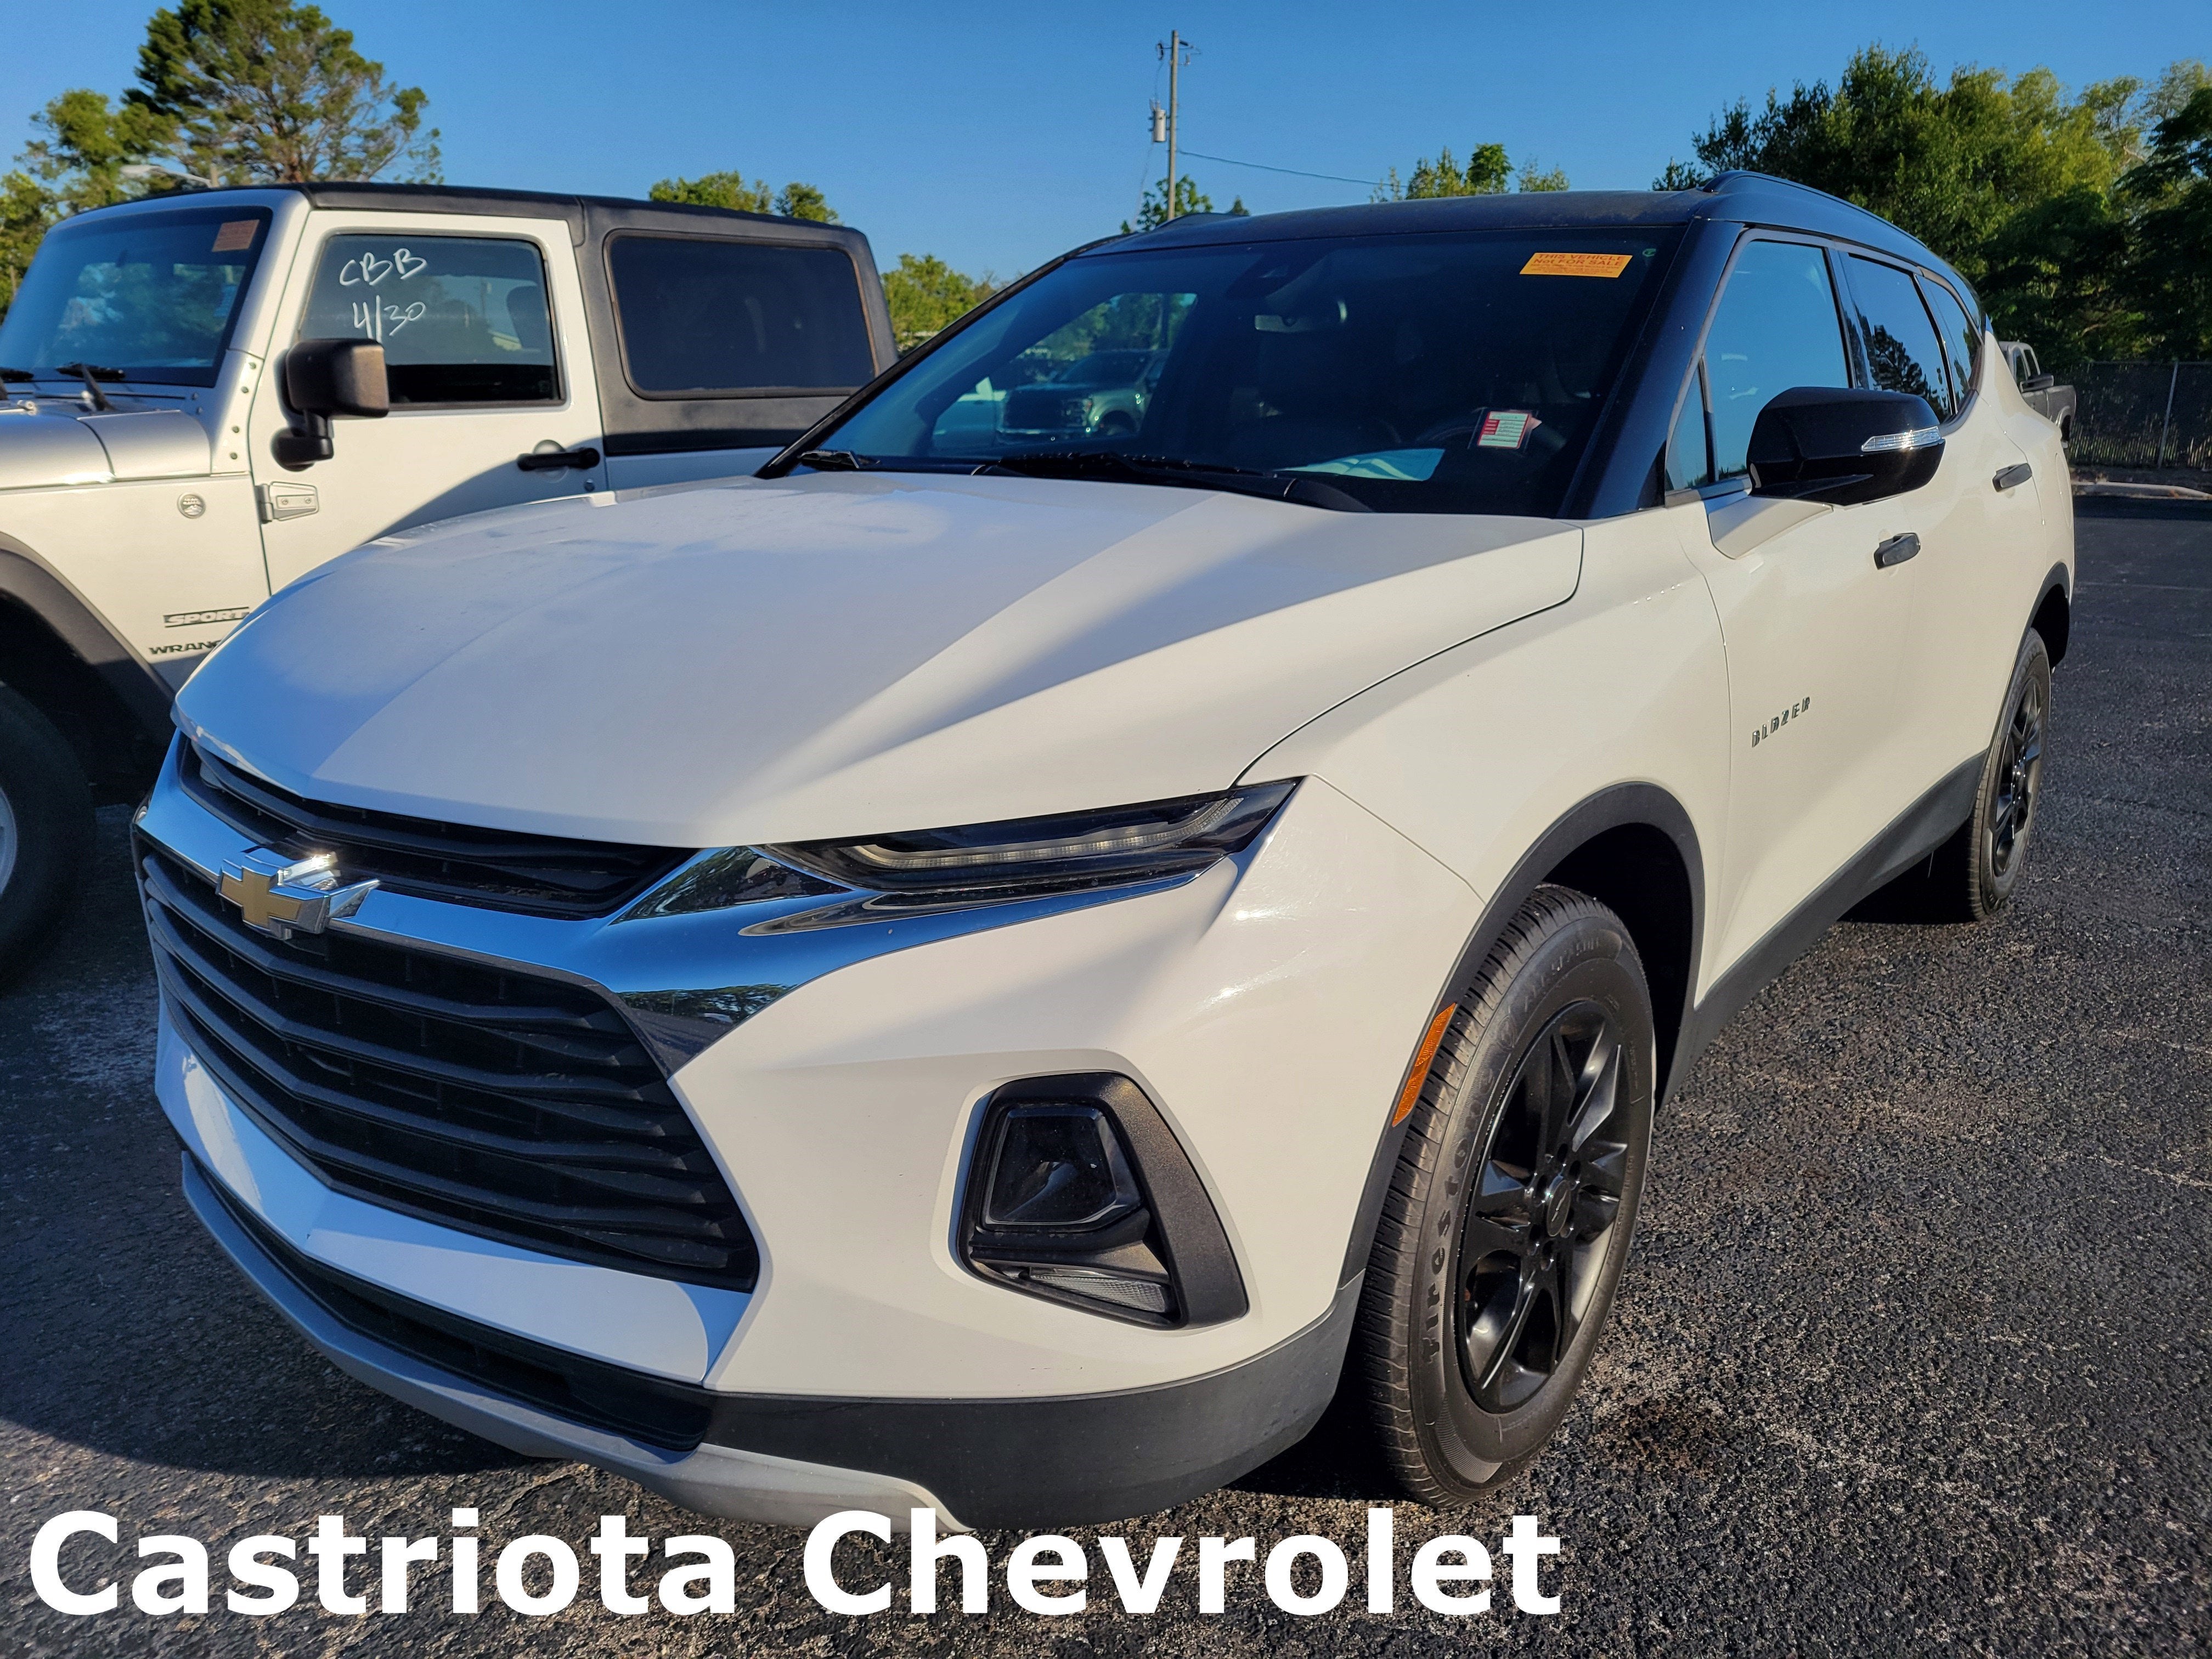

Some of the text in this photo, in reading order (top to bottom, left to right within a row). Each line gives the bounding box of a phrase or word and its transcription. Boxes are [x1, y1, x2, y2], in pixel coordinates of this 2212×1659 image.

[339, 248, 427, 286] CBB
[352, 295, 426, 343] 4/30
[167, 609, 249, 624] SPORT
[1752, 696, 1810, 748] BLAZER
